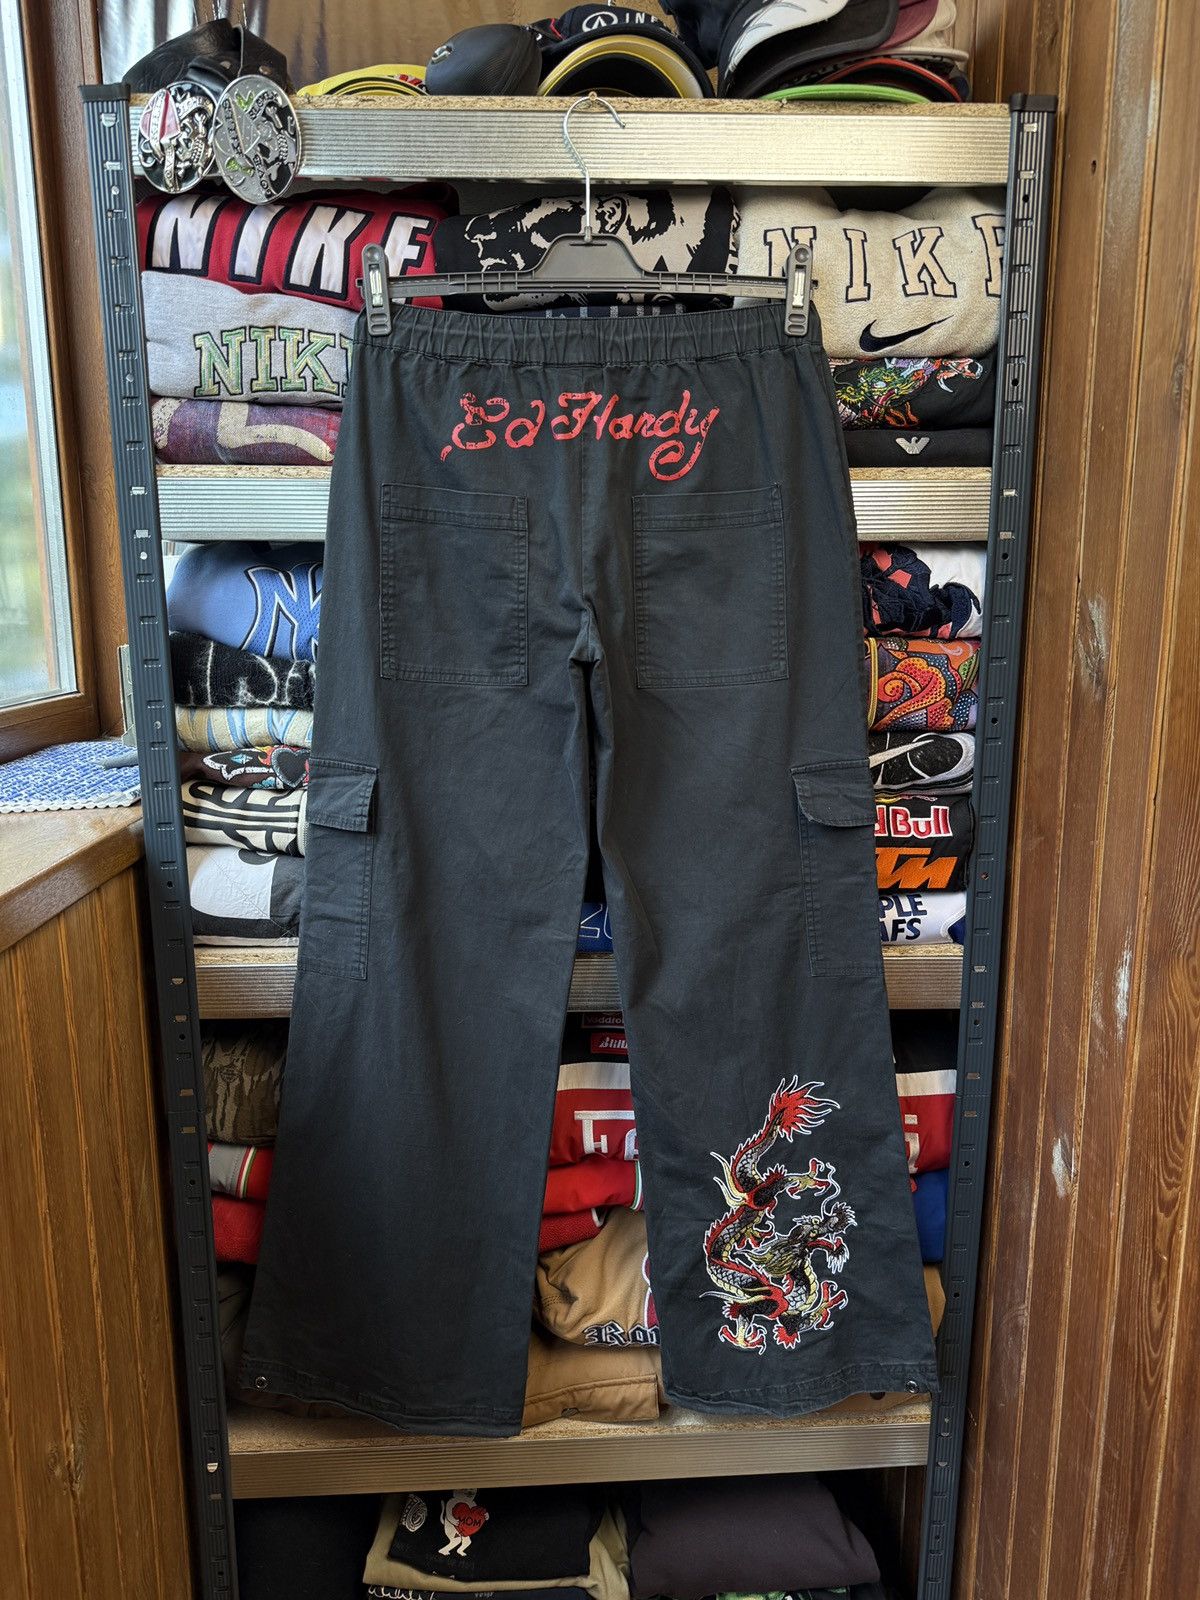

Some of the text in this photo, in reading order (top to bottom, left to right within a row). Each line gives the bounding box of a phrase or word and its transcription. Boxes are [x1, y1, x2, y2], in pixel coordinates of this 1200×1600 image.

[440, 389, 721, 481] Ed Hardy
[890, 805, 953, 839] Bull
[879, 894, 928, 918] PLE
[459, 1516, 481, 1527] MOM
